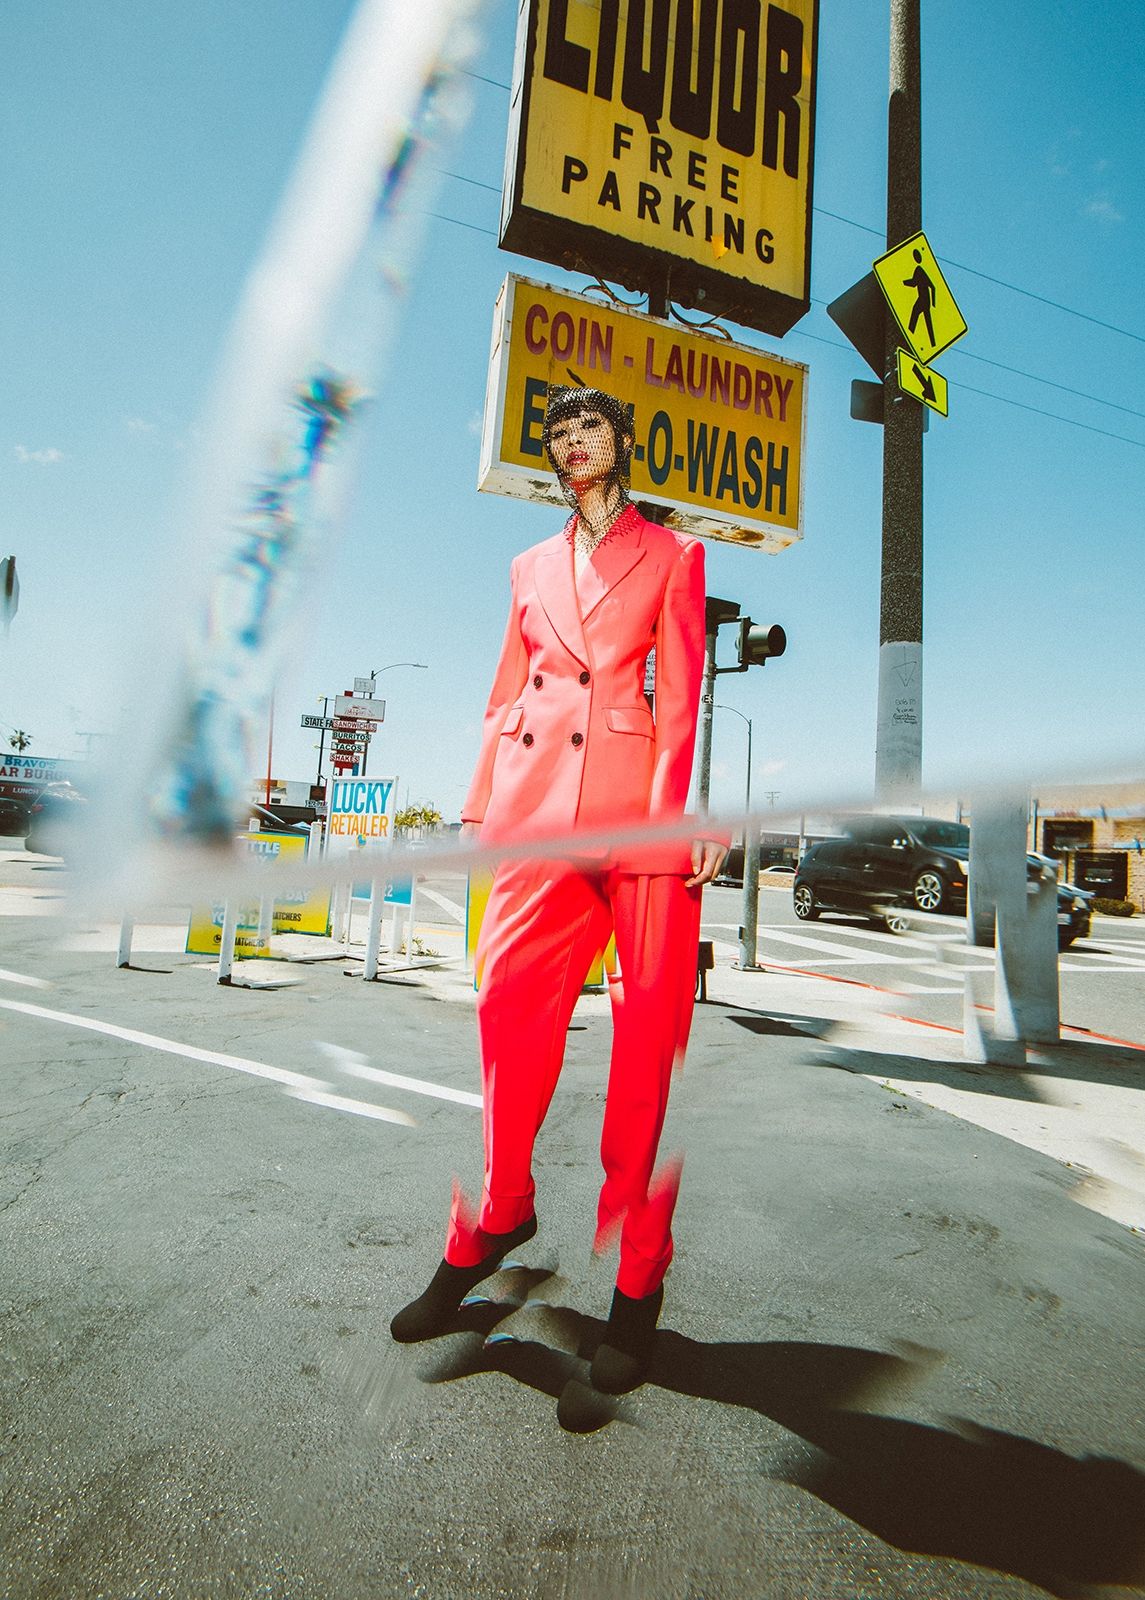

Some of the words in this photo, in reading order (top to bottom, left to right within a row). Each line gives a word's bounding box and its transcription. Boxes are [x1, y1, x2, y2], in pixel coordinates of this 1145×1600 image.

[543, 0, 805, 180] LIQUOR
[612, 123, 740, 205] FREE
[561, 155, 775, 264] PARKING
[525, 303, 614, 374] COIN
[645, 336, 793, 422] LAUNDRY
[519, 376, 789, 516] E-O-WASH
[304, 716, 324, 728] STATE
[333, 719, 377, 732] SANDWICHES
[333, 732, 371, 742] BURRITOS
[334, 743, 362, 752] TACOS
[4, 755, 57, 769] BRAVO'S
[330, 753, 360, 763] SHAKES
[332, 782, 393, 814] LUCKY
[330, 814, 389, 837] RETAILER
